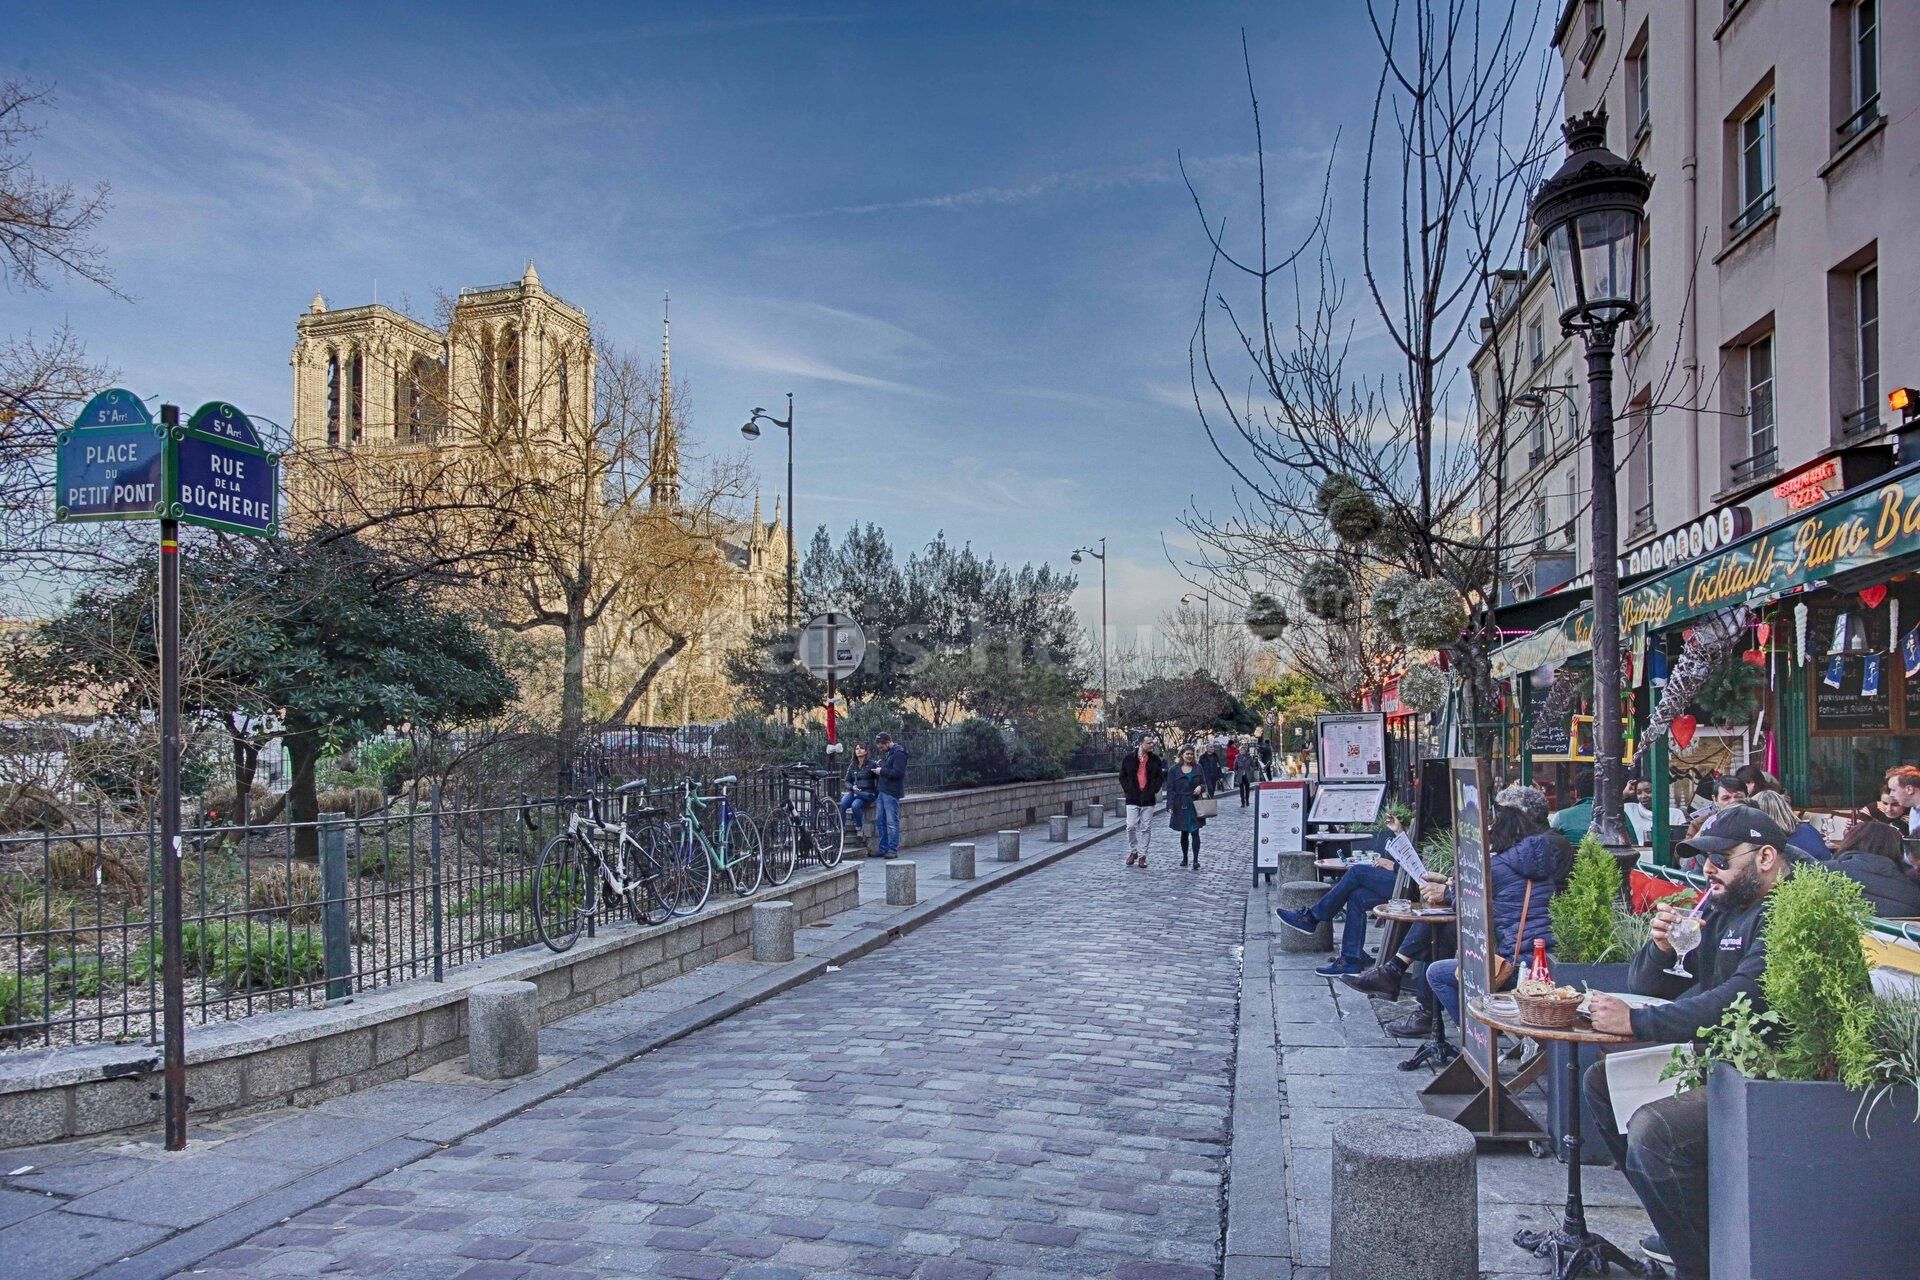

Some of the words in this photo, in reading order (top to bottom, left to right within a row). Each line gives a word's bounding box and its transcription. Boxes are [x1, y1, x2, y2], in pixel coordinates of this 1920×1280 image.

[86, 443, 137, 464] PLACE
[105, 469, 118, 480] DU
[211, 454, 245, 479] RUE
[68, 484, 109, 506] PETIT
[114, 483, 155, 504] PONT
[215, 477, 227, 489] DE
[229, 481, 241, 492] LA
[1688, 536, 1775, 607] Cocktails
[1786, 516, 1869, 575] Piano
